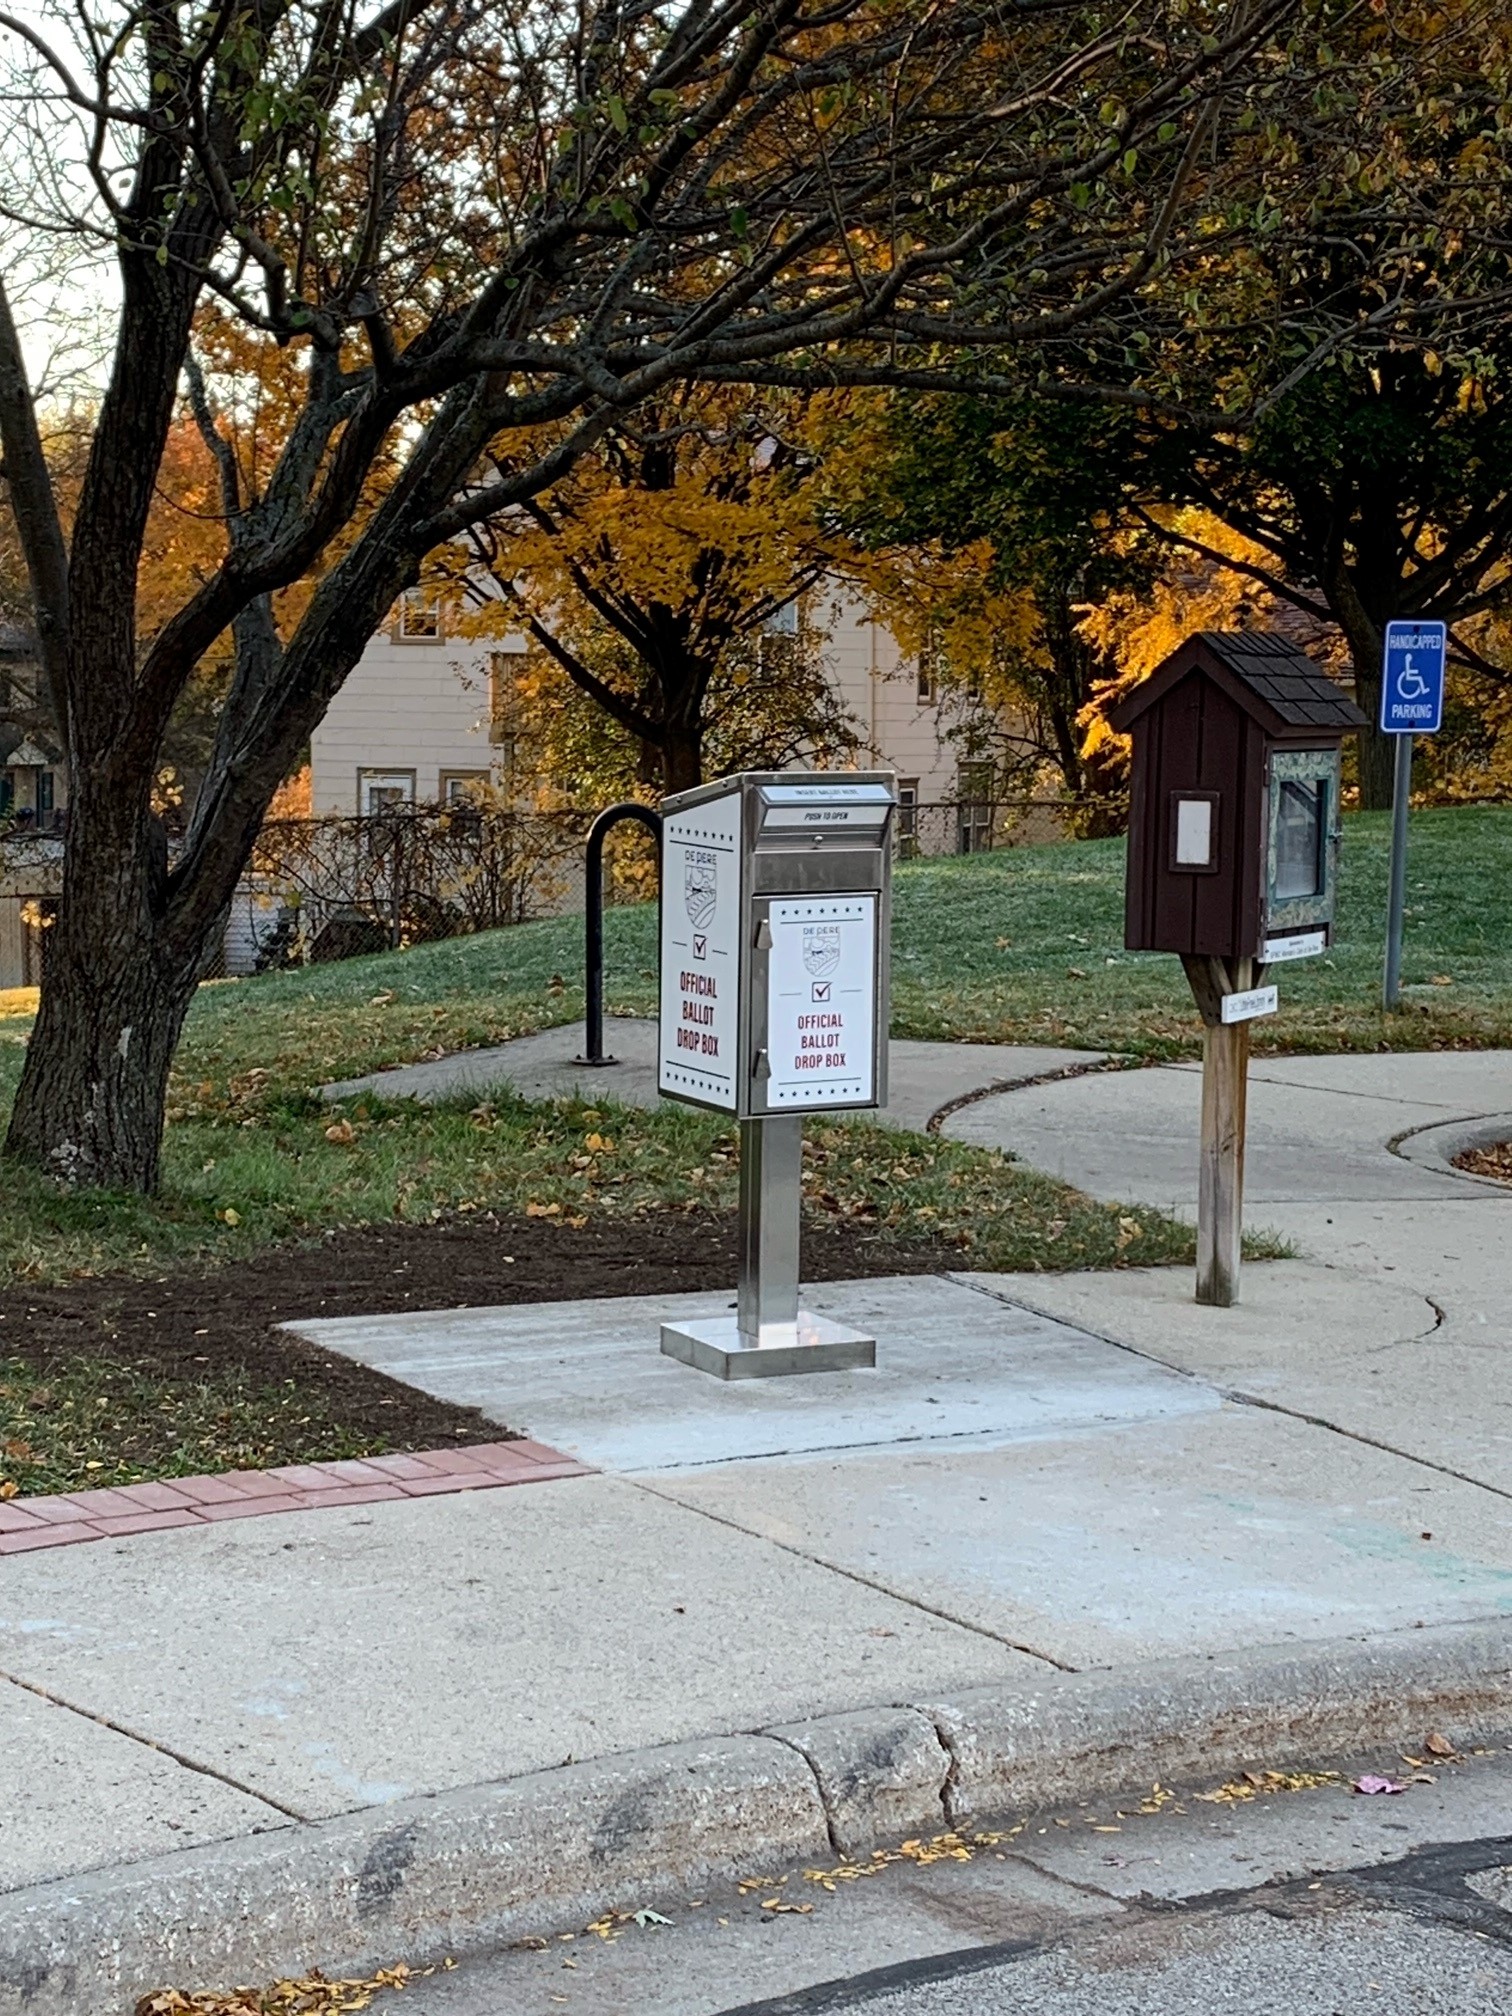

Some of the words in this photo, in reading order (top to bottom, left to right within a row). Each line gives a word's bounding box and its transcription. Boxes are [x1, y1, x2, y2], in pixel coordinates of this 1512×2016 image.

[1389, 634, 1442, 650] HANDICAPPED
[1391, 703, 1433, 719] PARKING
[804, 811, 822, 821] PUSH
[823, 811, 831, 820] TO
[831, 811, 849, 820] OPEN
[685, 849, 695, 862] DE
[803, 927, 815, 935] DE
[816, 926, 840, 935] PERE
[680, 970, 717, 999] OFFICIAL
[682, 1000, 714, 1027] BALLOT
[797, 1013, 844, 1030] OFFICIAL
[677, 1027, 700, 1052] DROP
[701, 1033, 719, 1057] BOX
[801, 1033, 840, 1049] BALLOT
[794, 1054, 823, 1070] DROP
[825, 1053, 847, 1068] BOX
